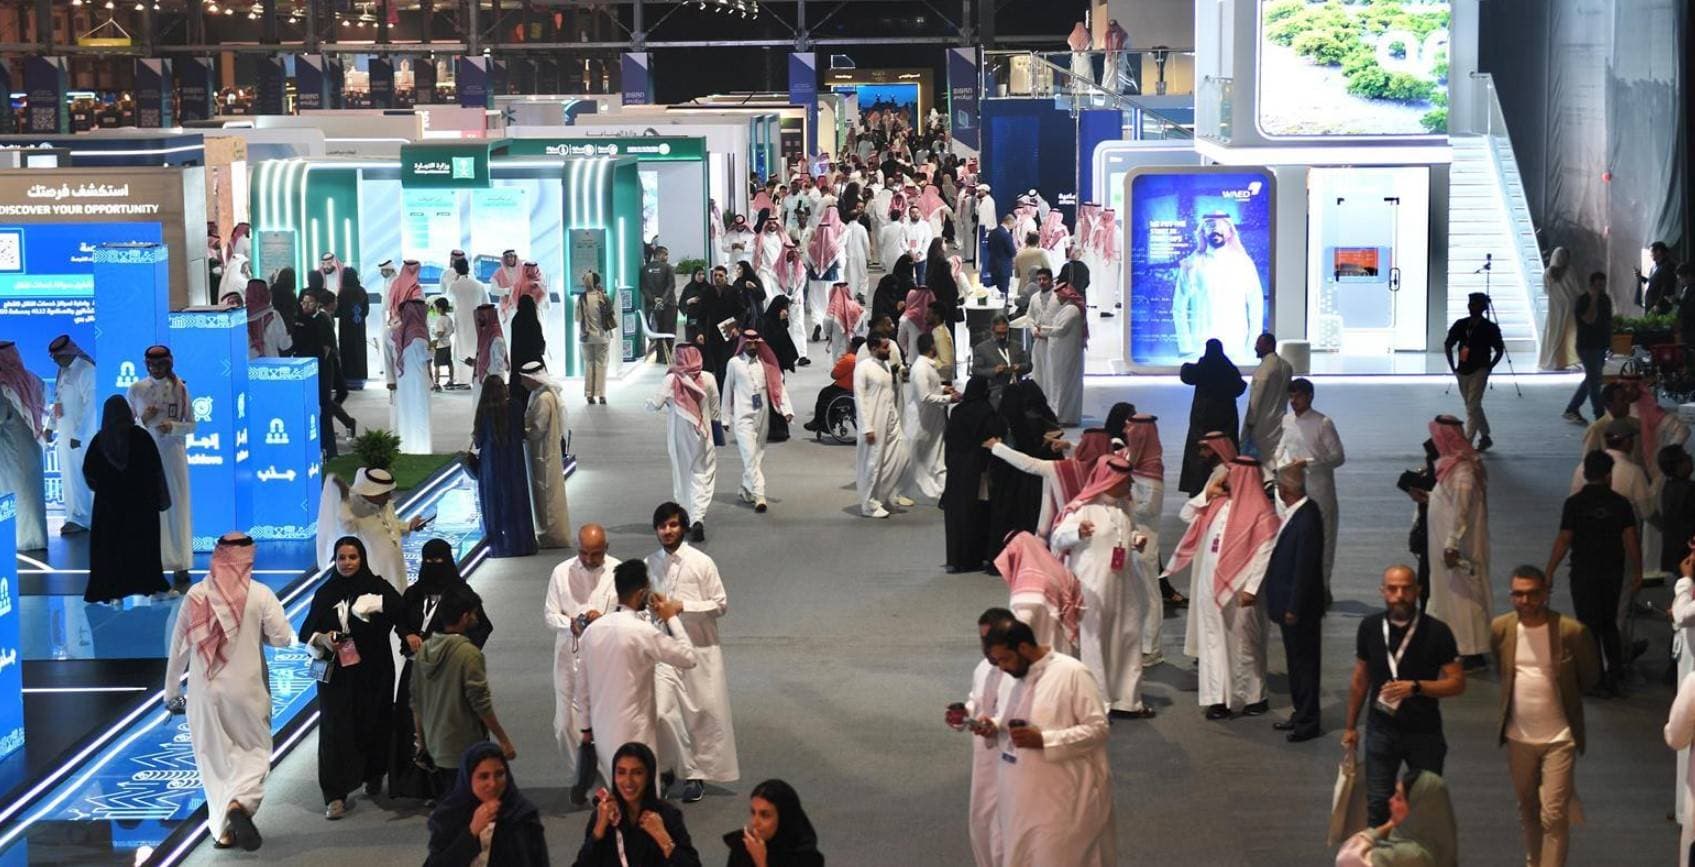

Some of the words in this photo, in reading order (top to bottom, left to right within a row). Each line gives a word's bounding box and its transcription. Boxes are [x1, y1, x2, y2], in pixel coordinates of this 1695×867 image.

[27, 183, 70, 200] فرصتك
[71, 182, 129, 198] استكشف
[0, 204, 50, 215] DISCOVER
[50, 204, 84, 215] YOUR
[84, 204, 159, 215] OPPORTUNITY
